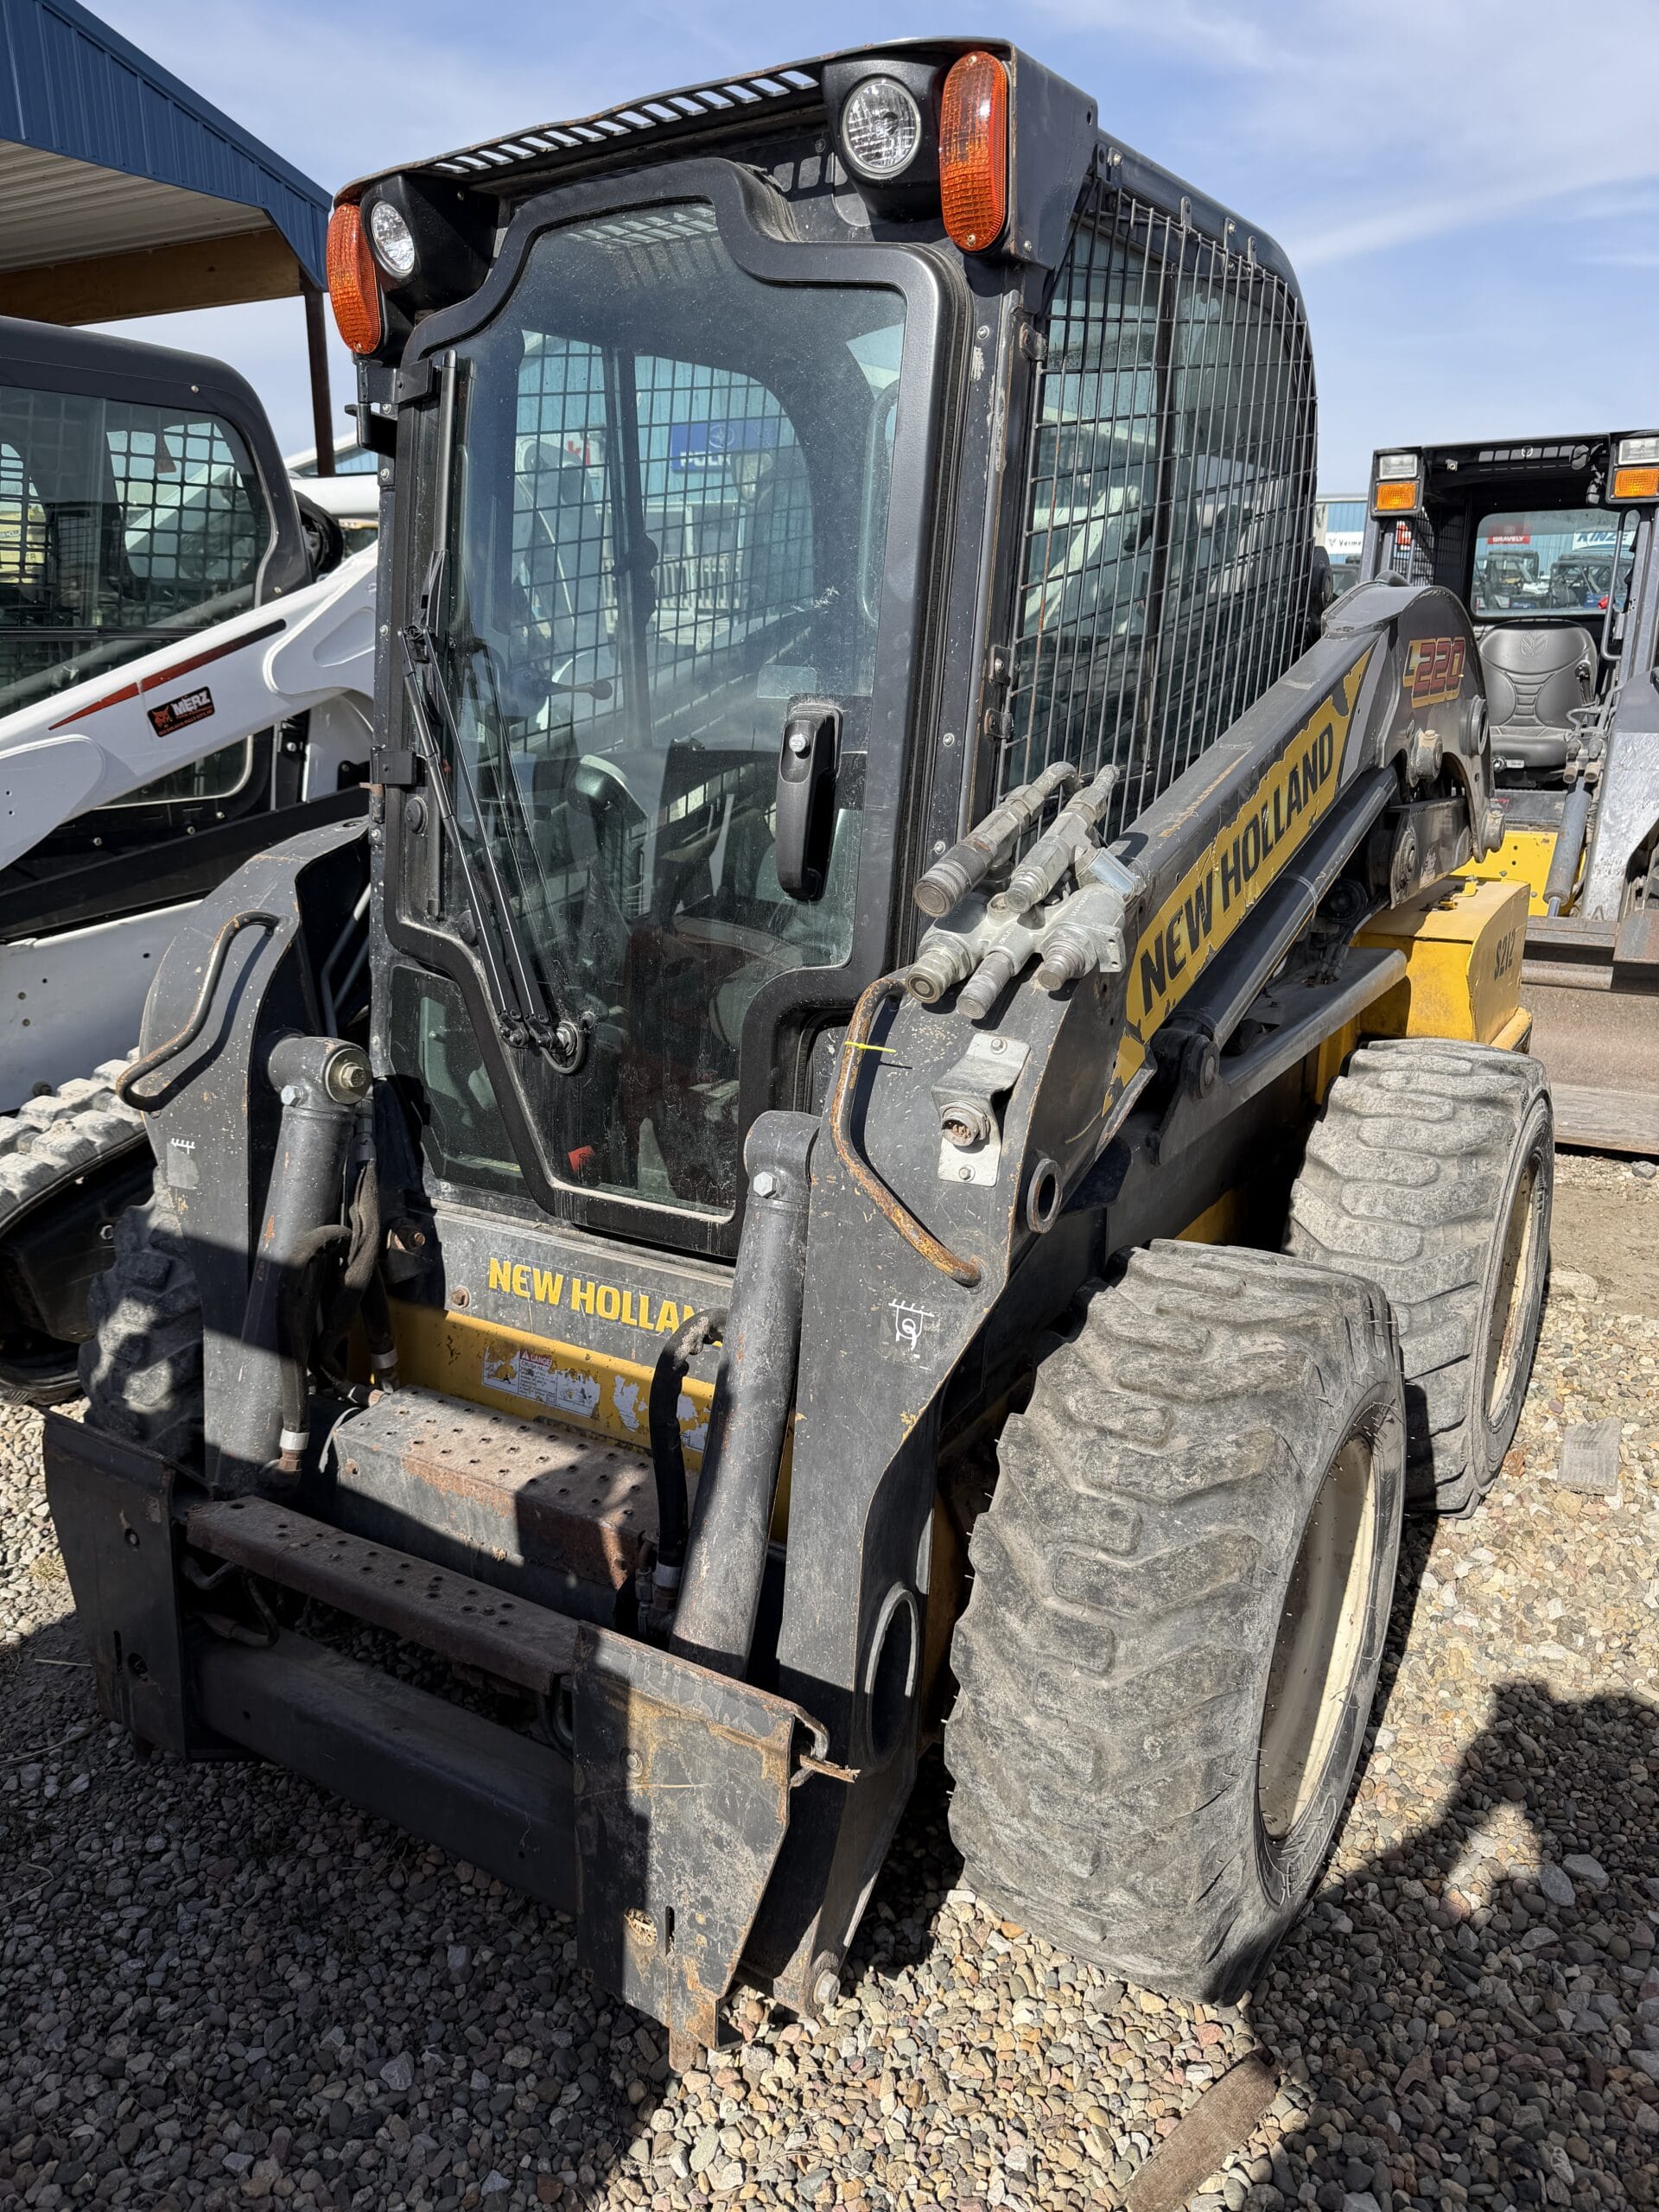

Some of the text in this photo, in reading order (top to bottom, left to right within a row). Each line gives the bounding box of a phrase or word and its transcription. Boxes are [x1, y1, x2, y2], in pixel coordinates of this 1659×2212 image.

[171, 690, 209, 715] MERZ
[1403, 637, 1465, 707] L220
[1140, 721, 1333, 1017] NEW HOLLAND
[488, 1257, 707, 1336] NEW HOLLA
[530, 1354, 552, 1365] DANGE
